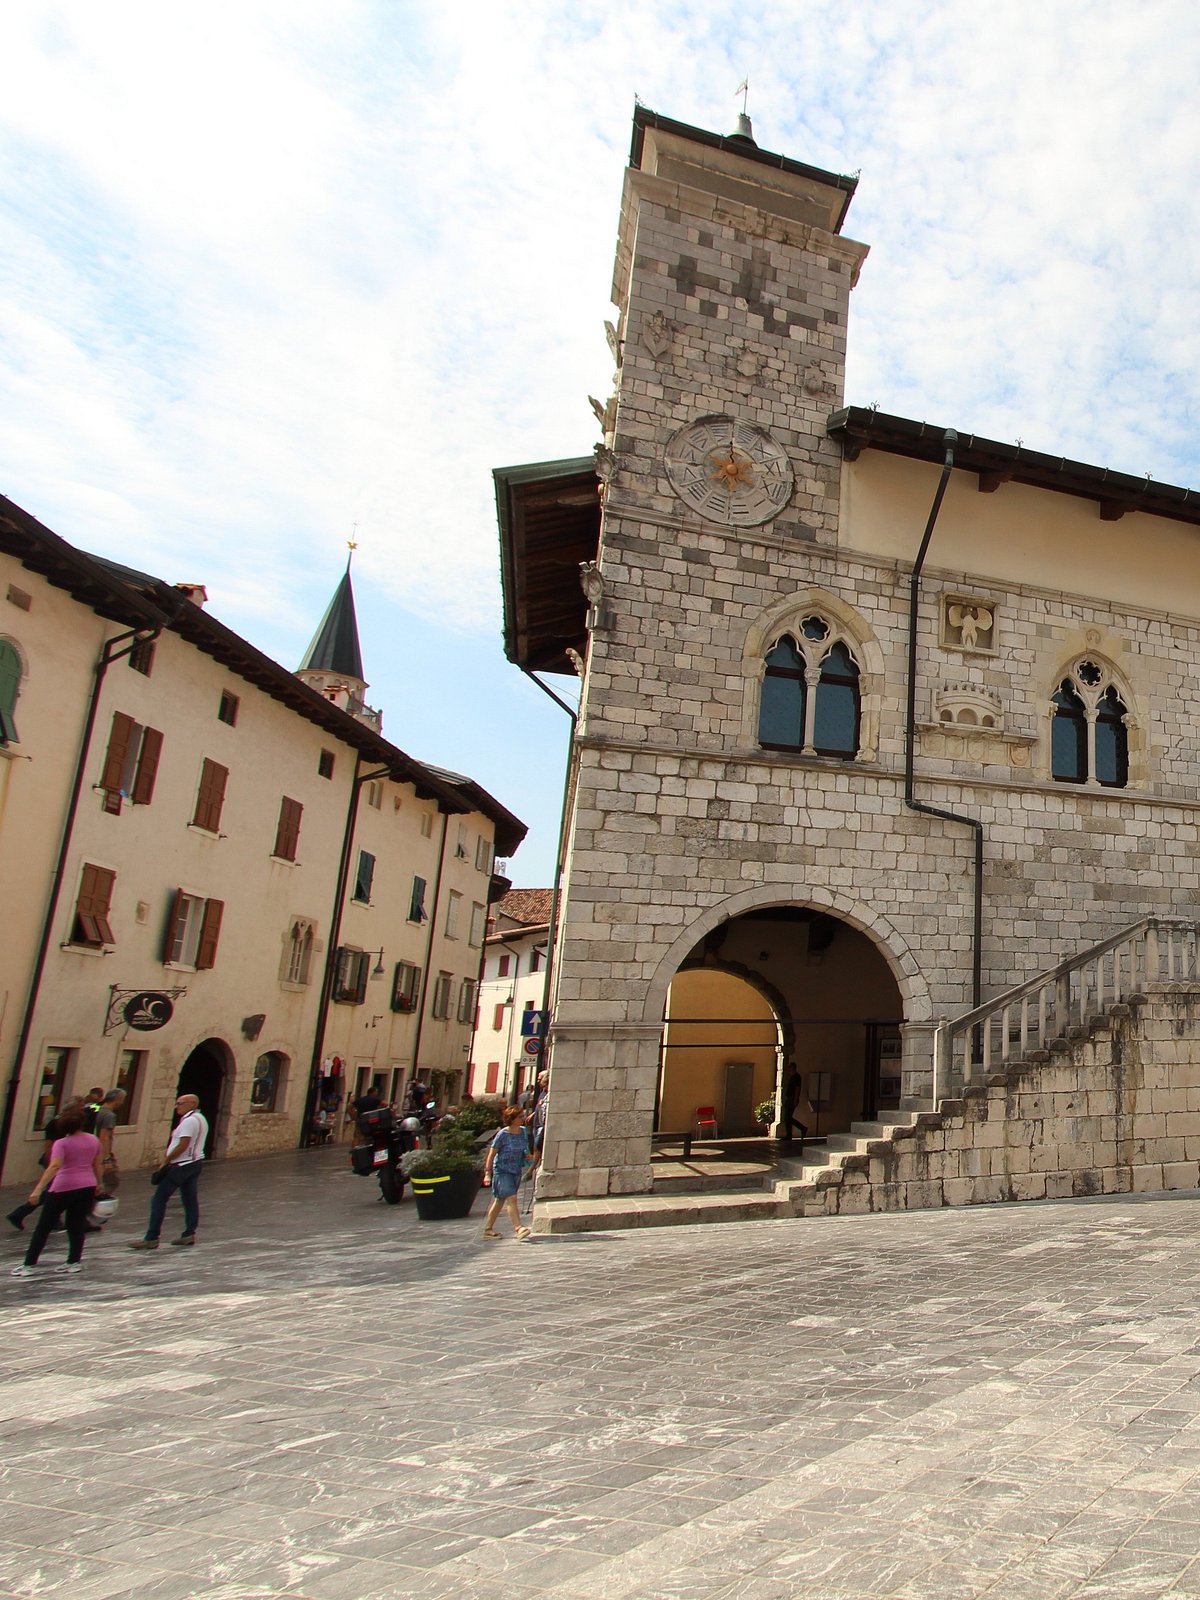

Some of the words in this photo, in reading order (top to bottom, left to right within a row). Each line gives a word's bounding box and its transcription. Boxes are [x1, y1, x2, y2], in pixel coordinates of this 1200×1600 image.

[754, 442, 772, 458] X
[764, 462, 782, 477] XI
[688, 482, 707, 501] IIII
[760, 480, 782, 499] XII
[707, 497, 725, 514] III
[732, 504, 749, 515] II
